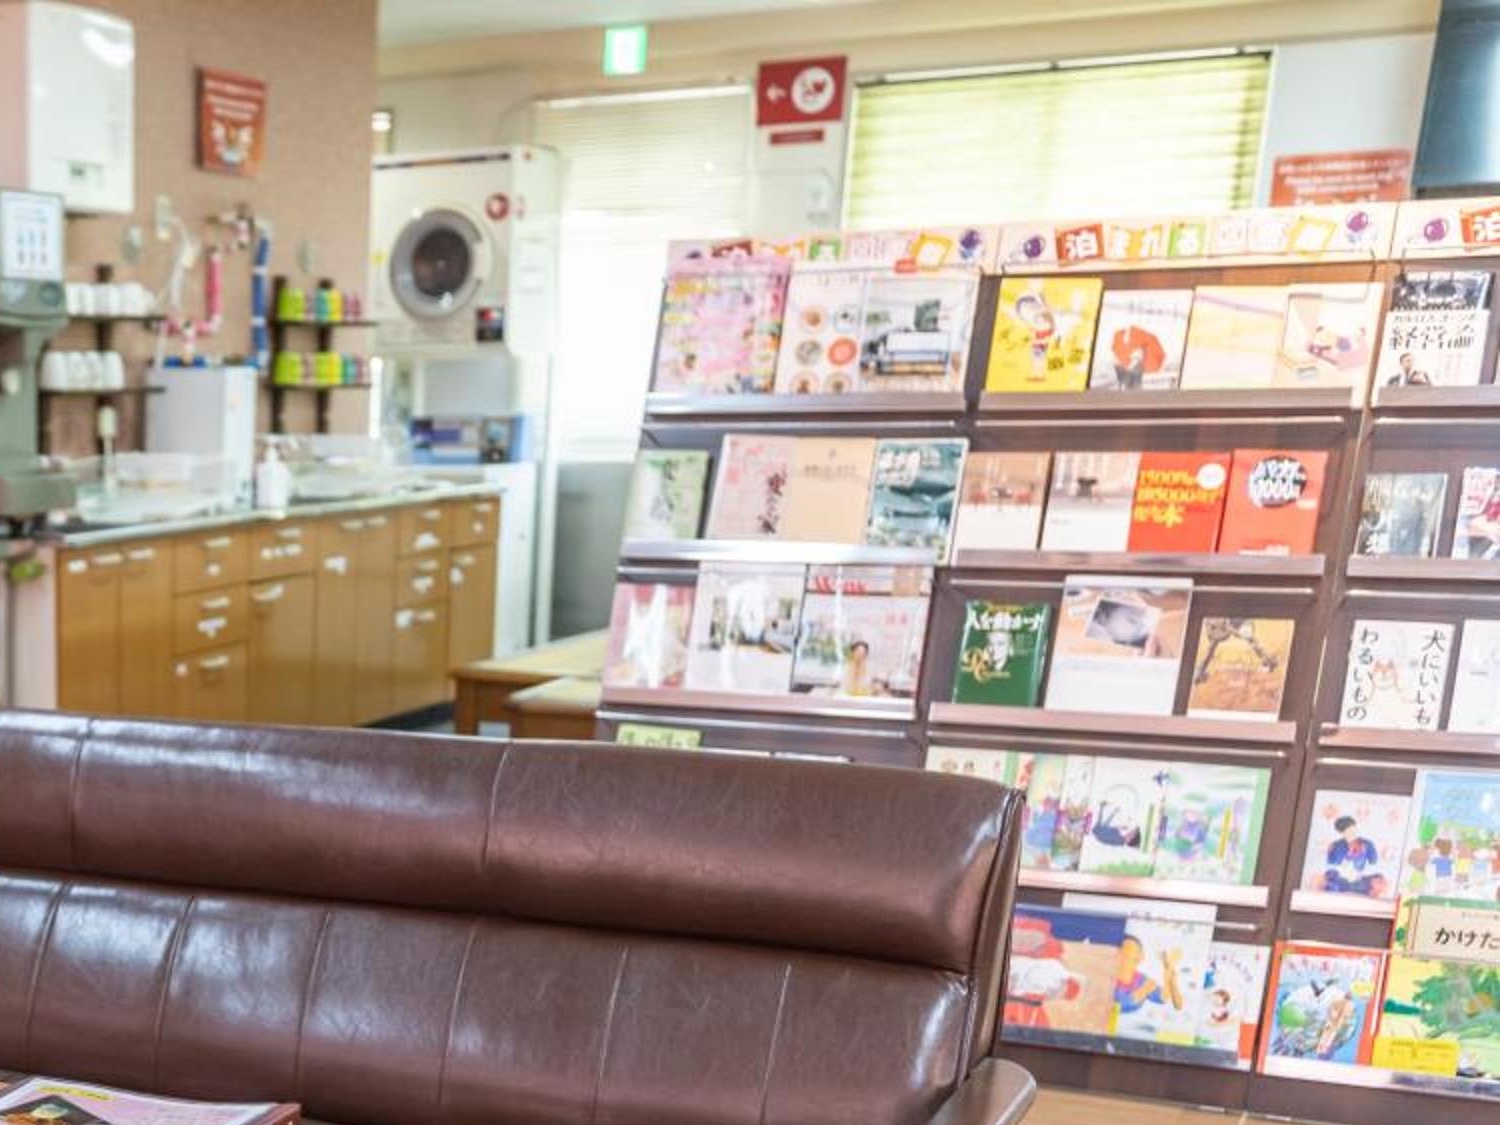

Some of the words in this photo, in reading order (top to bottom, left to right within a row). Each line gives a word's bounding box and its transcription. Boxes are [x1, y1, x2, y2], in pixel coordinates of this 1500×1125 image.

[1346, 626, 1379, 721] わるいもの
